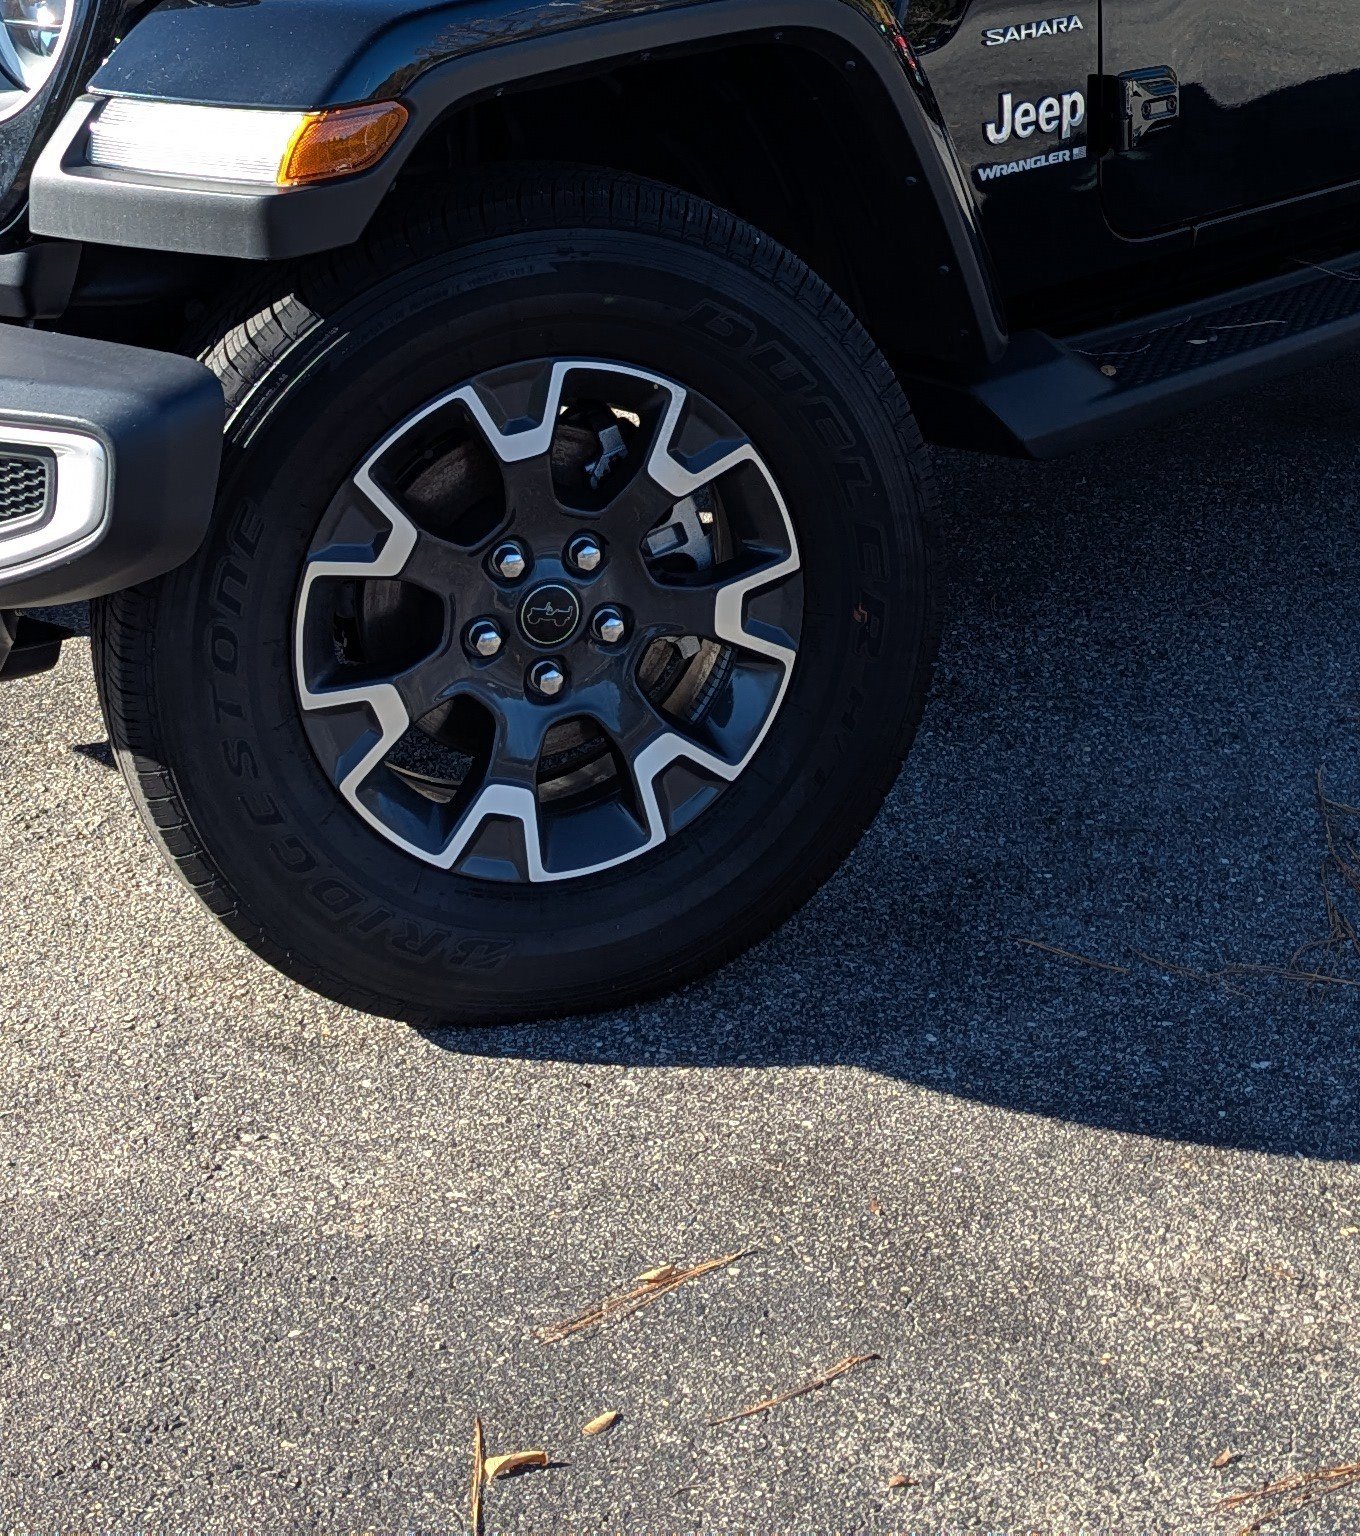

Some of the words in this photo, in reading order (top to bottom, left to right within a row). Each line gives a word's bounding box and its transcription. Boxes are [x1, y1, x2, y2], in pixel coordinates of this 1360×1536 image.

[983, 15, 1084, 46] SAHARA
[983, 90, 1086, 145] Jeep
[977, 149, 1071, 182] WRANGLER
[680, 298, 890, 660] DUELER
[202, 498, 517, 971] BRIDGESTONE
